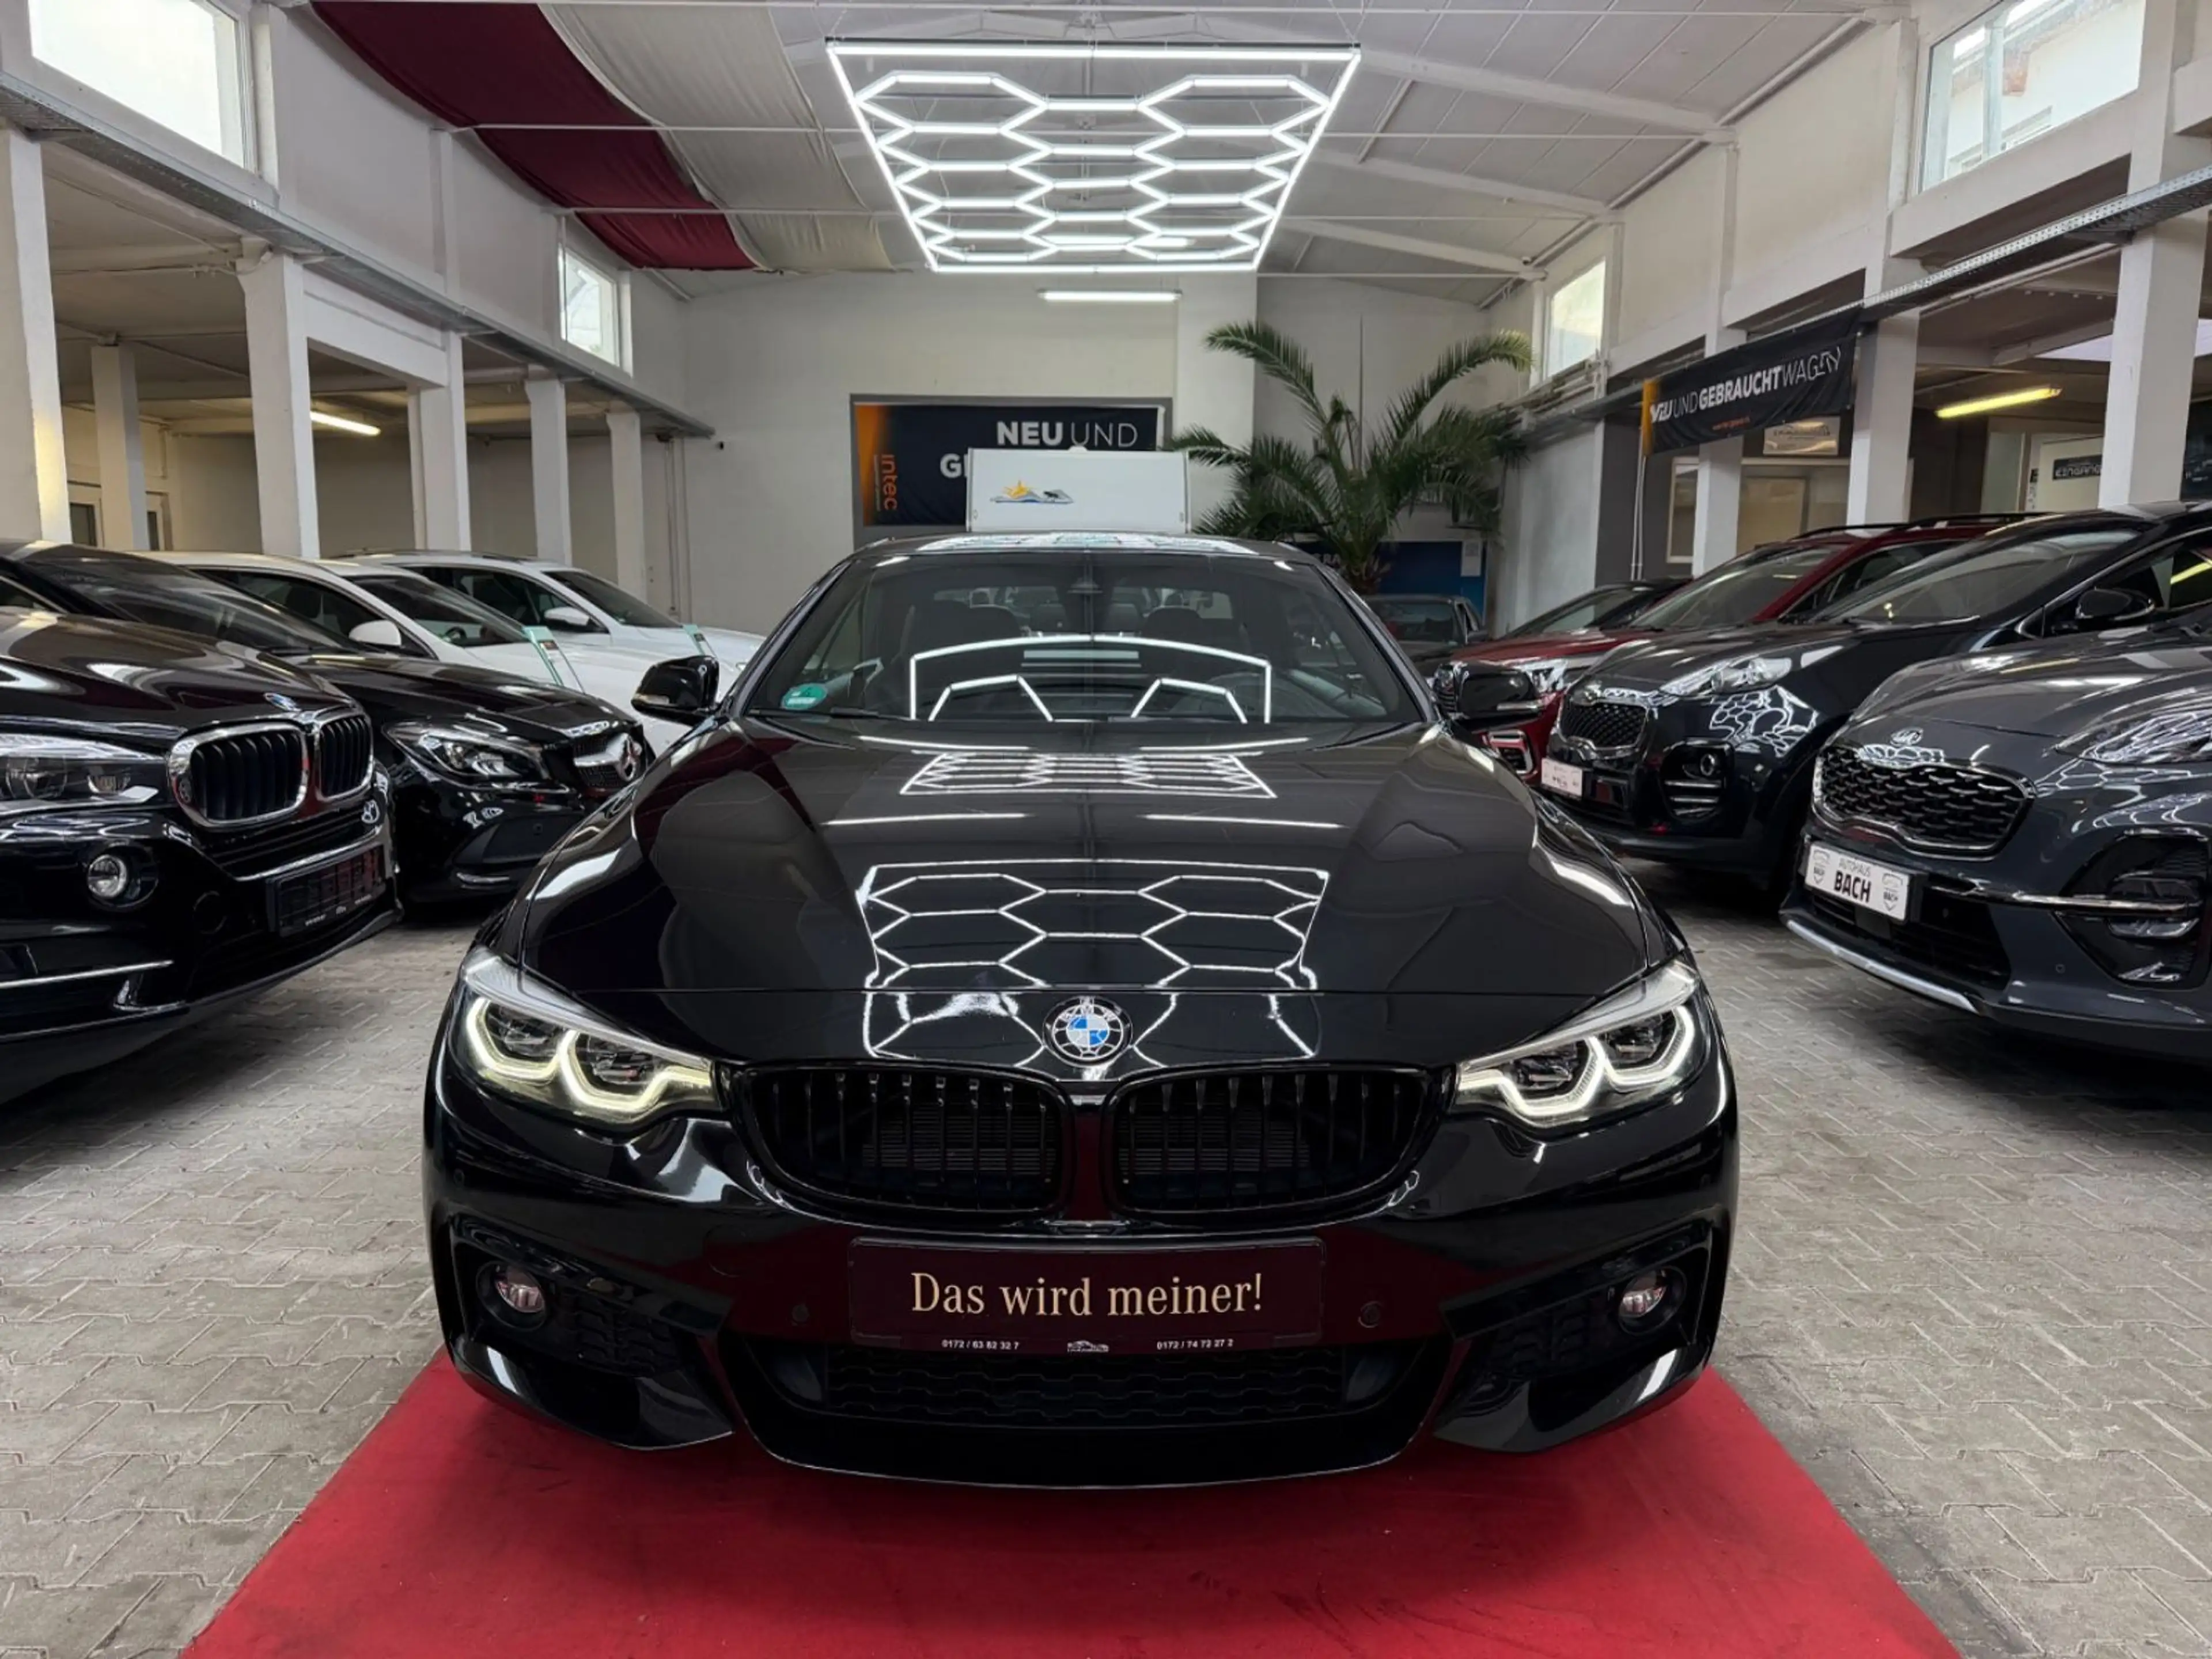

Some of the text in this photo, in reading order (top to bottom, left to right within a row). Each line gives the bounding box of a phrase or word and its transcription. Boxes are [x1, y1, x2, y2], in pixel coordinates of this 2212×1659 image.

[997, 421, 1138, 448] NEU UND
[1834, 870, 1872, 903] BACH
[911, 1272, 1262, 1316] Das wird meiner!
